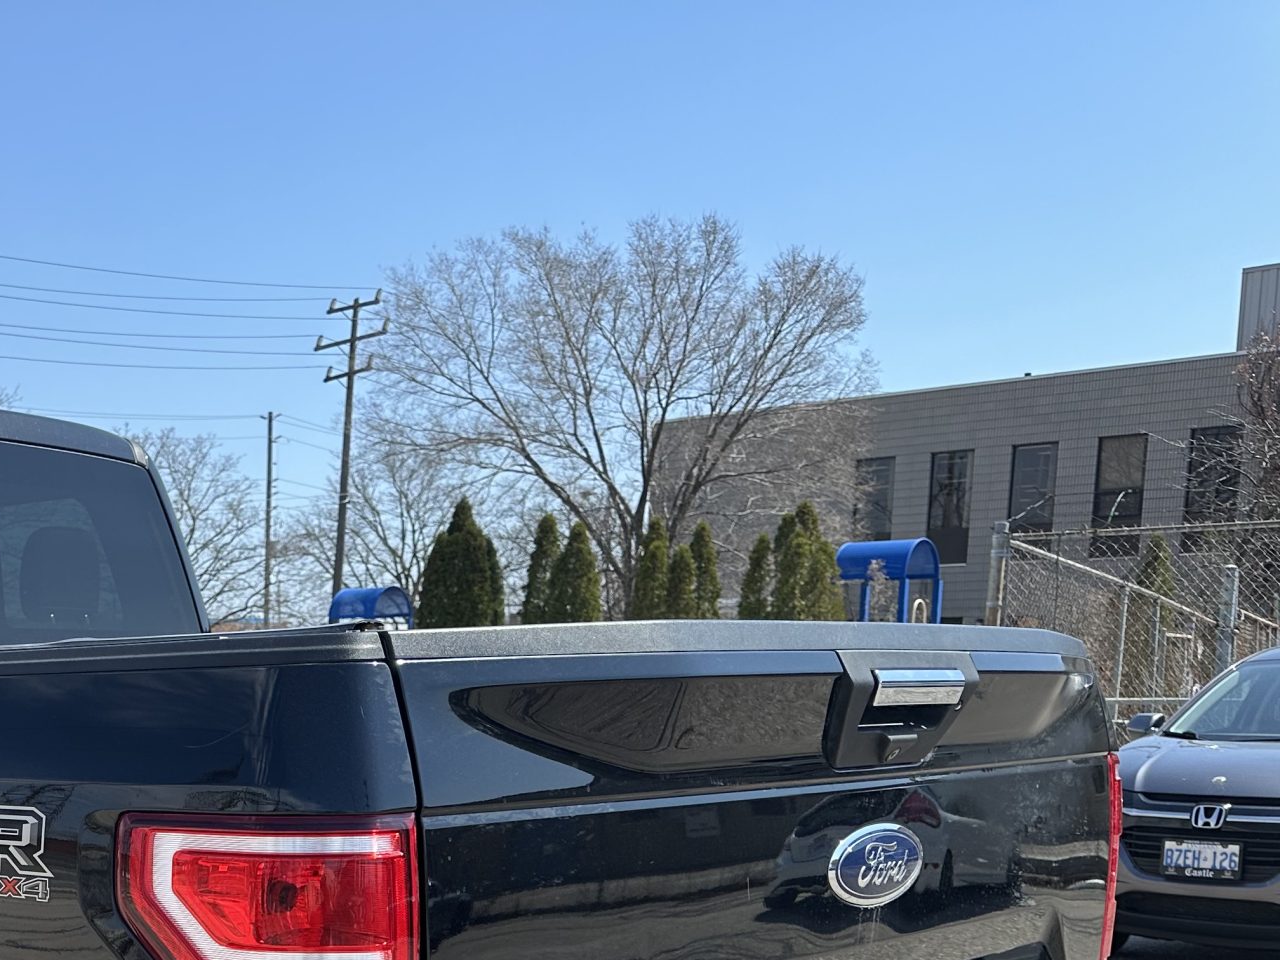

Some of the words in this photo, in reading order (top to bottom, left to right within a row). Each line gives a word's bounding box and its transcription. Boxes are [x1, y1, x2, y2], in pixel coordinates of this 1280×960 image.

[857, 841, 909, 888] Ford
[1165, 848, 1201, 868] BZEH
[1211, 851, 1239, 872] 126
